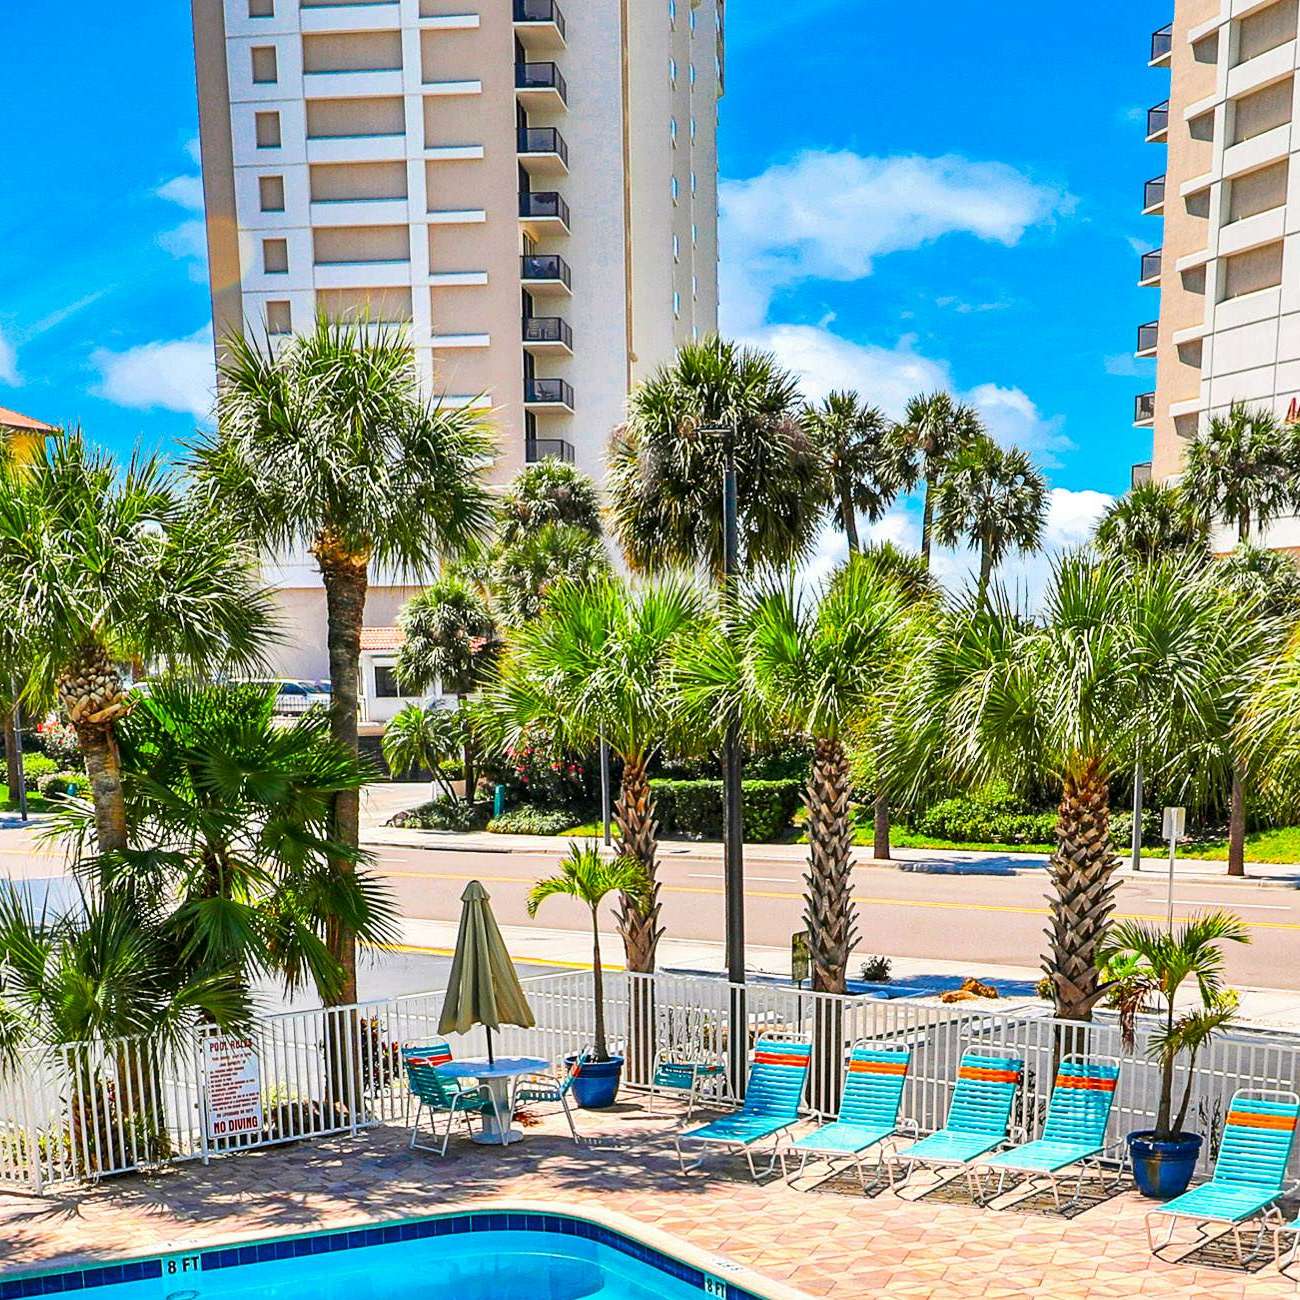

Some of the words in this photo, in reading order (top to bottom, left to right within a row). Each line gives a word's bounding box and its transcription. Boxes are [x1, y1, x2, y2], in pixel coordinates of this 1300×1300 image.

[210, 1041, 228, 1052] POOL
[214, 1120, 226, 1134] NO
[228, 1116, 258, 1131] DIVING
[167, 1260, 177, 1274] 8
[181, 1256, 199, 1272] FT
[706, 1278, 713, 1292] 8
[715, 1281, 725, 1298] FT
